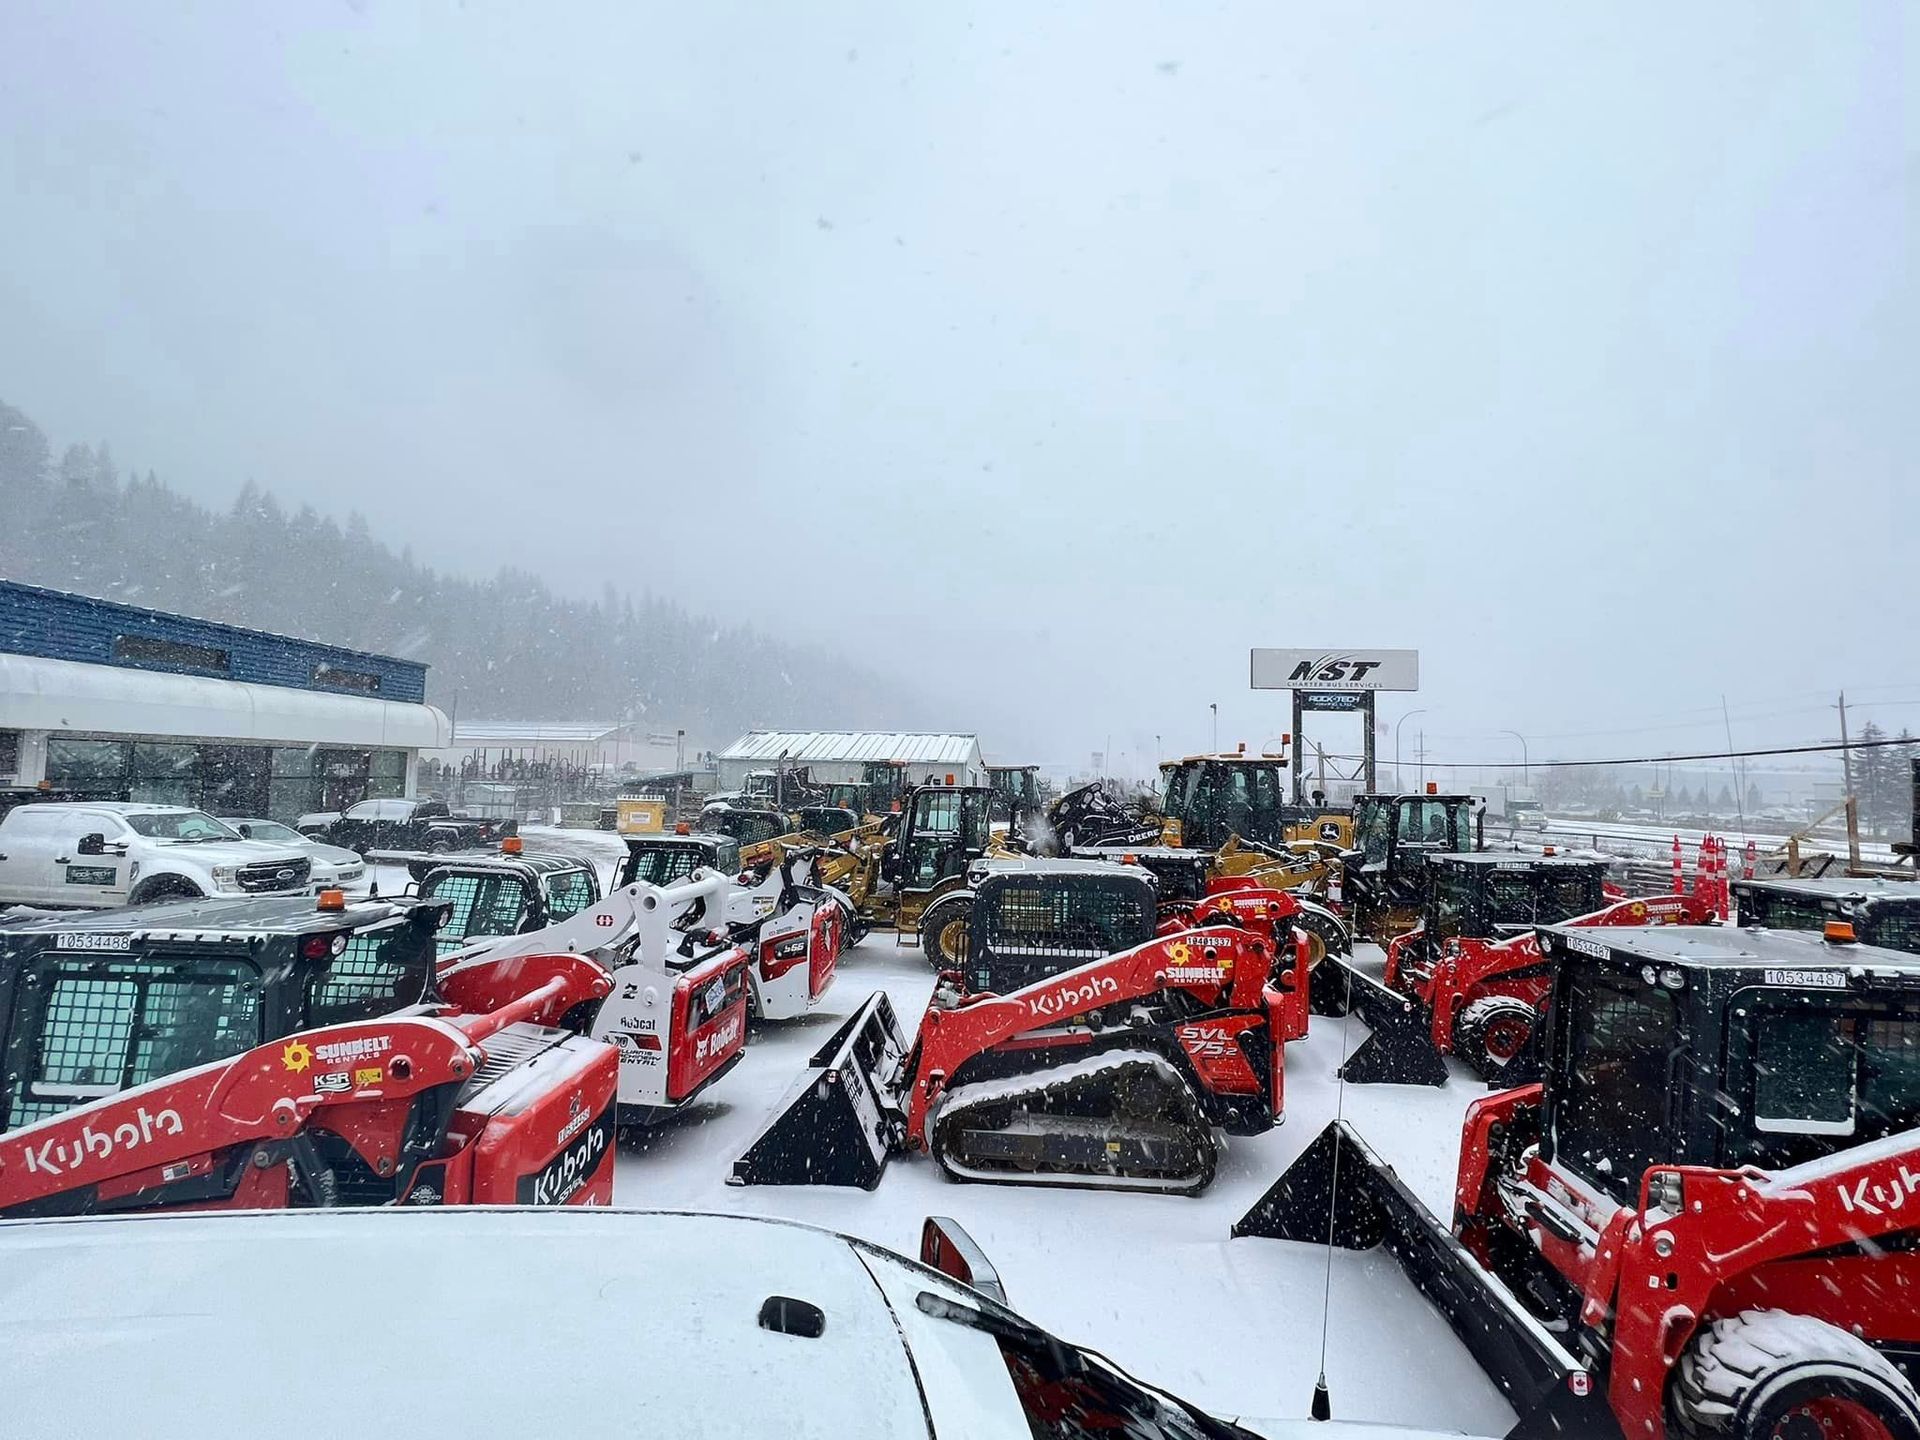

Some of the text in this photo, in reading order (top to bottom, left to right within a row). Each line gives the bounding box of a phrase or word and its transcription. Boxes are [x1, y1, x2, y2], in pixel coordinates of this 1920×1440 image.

[1288, 660, 1382, 681] NST
[1128, 829, 1160, 843] DEERE
[60, 935, 129, 949] 10534488
[1166, 968, 1227, 979] SUNBELT
[1767, 971, 1844, 986] 10534487
[1029, 975, 1119, 1015] Kubota
[1180, 1028, 1233, 1040] SVL
[315, 1036, 390, 1060] SUNBELT
[327, 1052, 380, 1065] RENTALS
[314, 1072, 350, 1086] KSR
[25, 1107, 183, 1175] Kubota
[534, 1128, 603, 1205] Kubota
